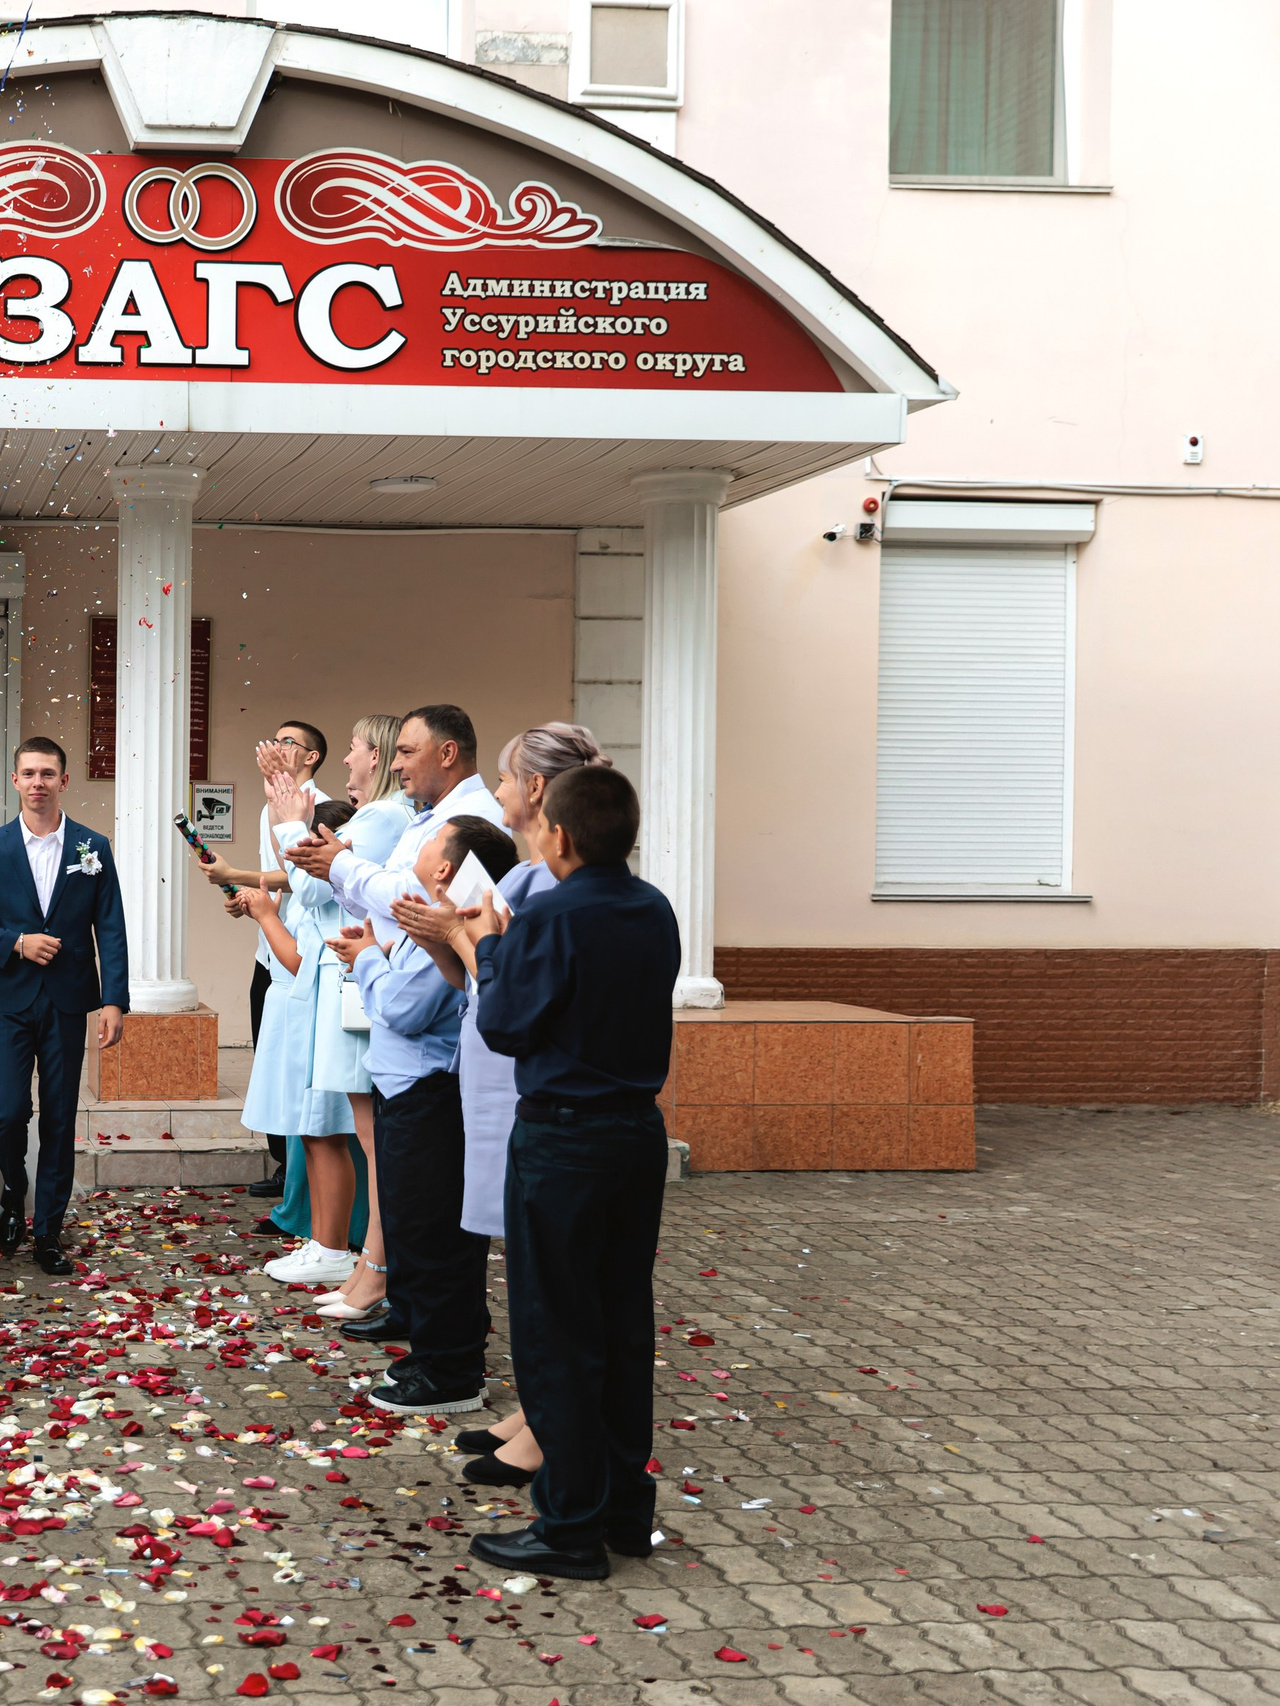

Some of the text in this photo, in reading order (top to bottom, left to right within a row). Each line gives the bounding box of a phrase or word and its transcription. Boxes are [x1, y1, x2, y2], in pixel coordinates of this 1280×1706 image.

[442, 272, 708, 305] Администрация
[442, 308, 668, 338] Уссурийского
[442, 349, 745, 377] городского округа
